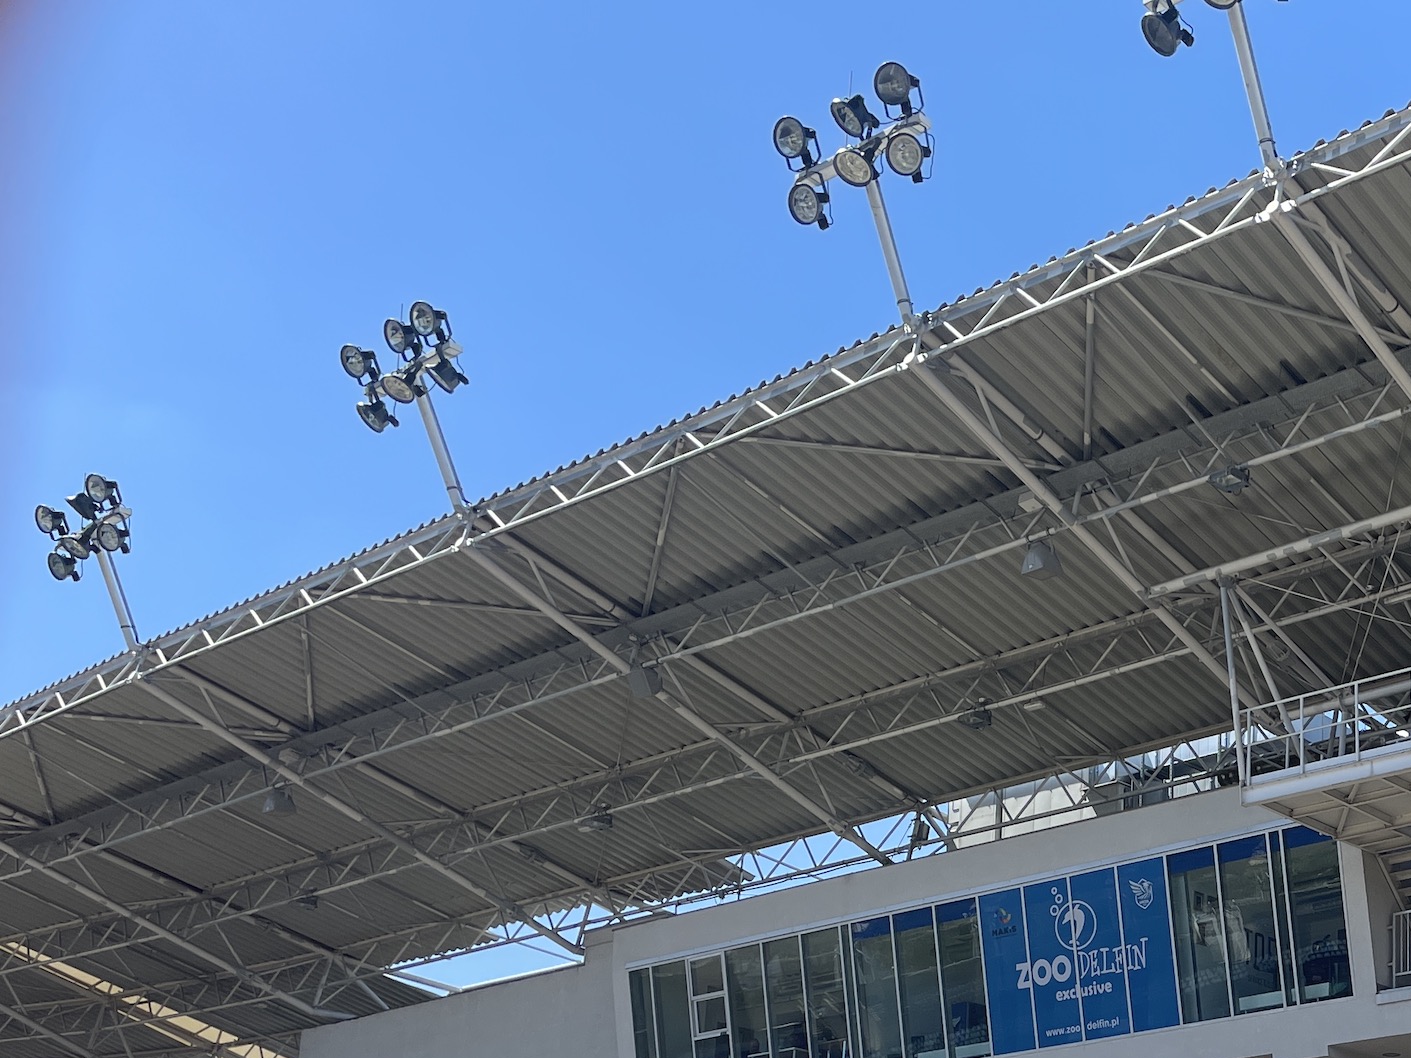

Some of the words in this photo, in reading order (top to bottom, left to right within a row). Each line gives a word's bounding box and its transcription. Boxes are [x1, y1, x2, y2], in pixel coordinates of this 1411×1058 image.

[1016, 955, 1072, 990] ZOO
[1078, 937, 1149, 979] DELFIN
[1055, 980, 1113, 1001] exclusive
[1045, 1016, 1120, 1037] www.zoodelfin.pl
